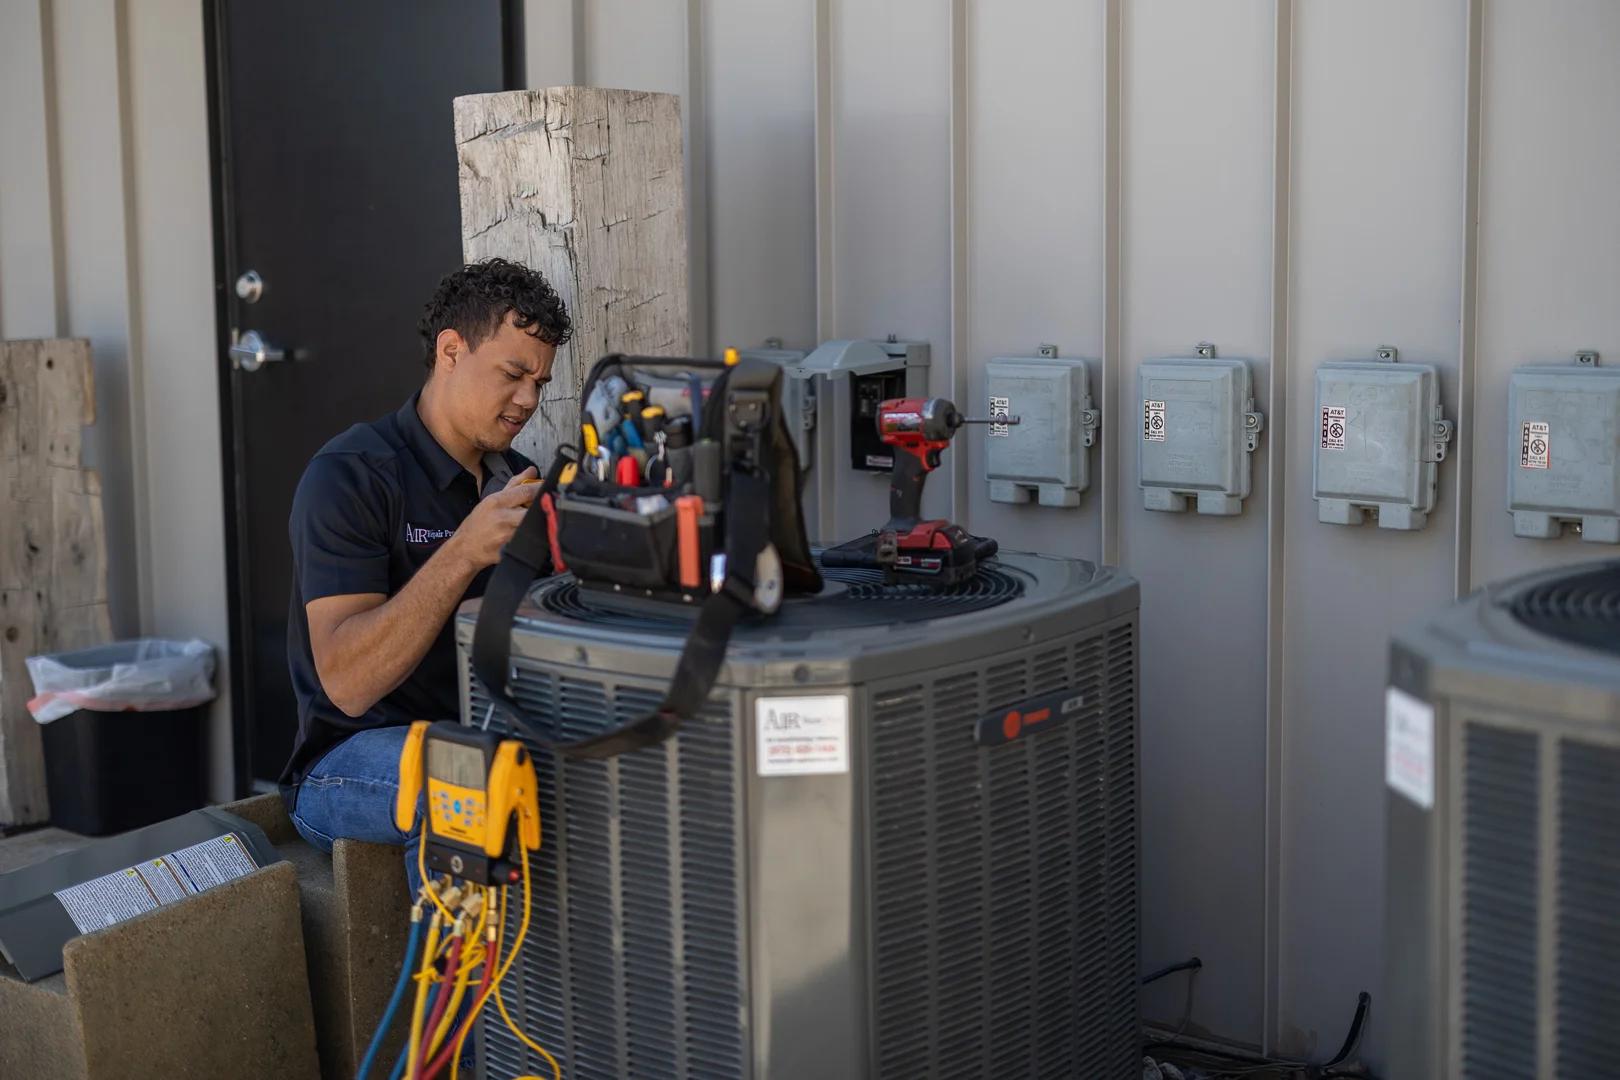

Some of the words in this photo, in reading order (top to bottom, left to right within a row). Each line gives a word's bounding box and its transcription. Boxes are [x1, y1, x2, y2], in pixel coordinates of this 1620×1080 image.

[1522, 423, 1530, 465] WARNING
[406, 522, 429, 543] AIR
[763, 707, 801, 730] AIR
